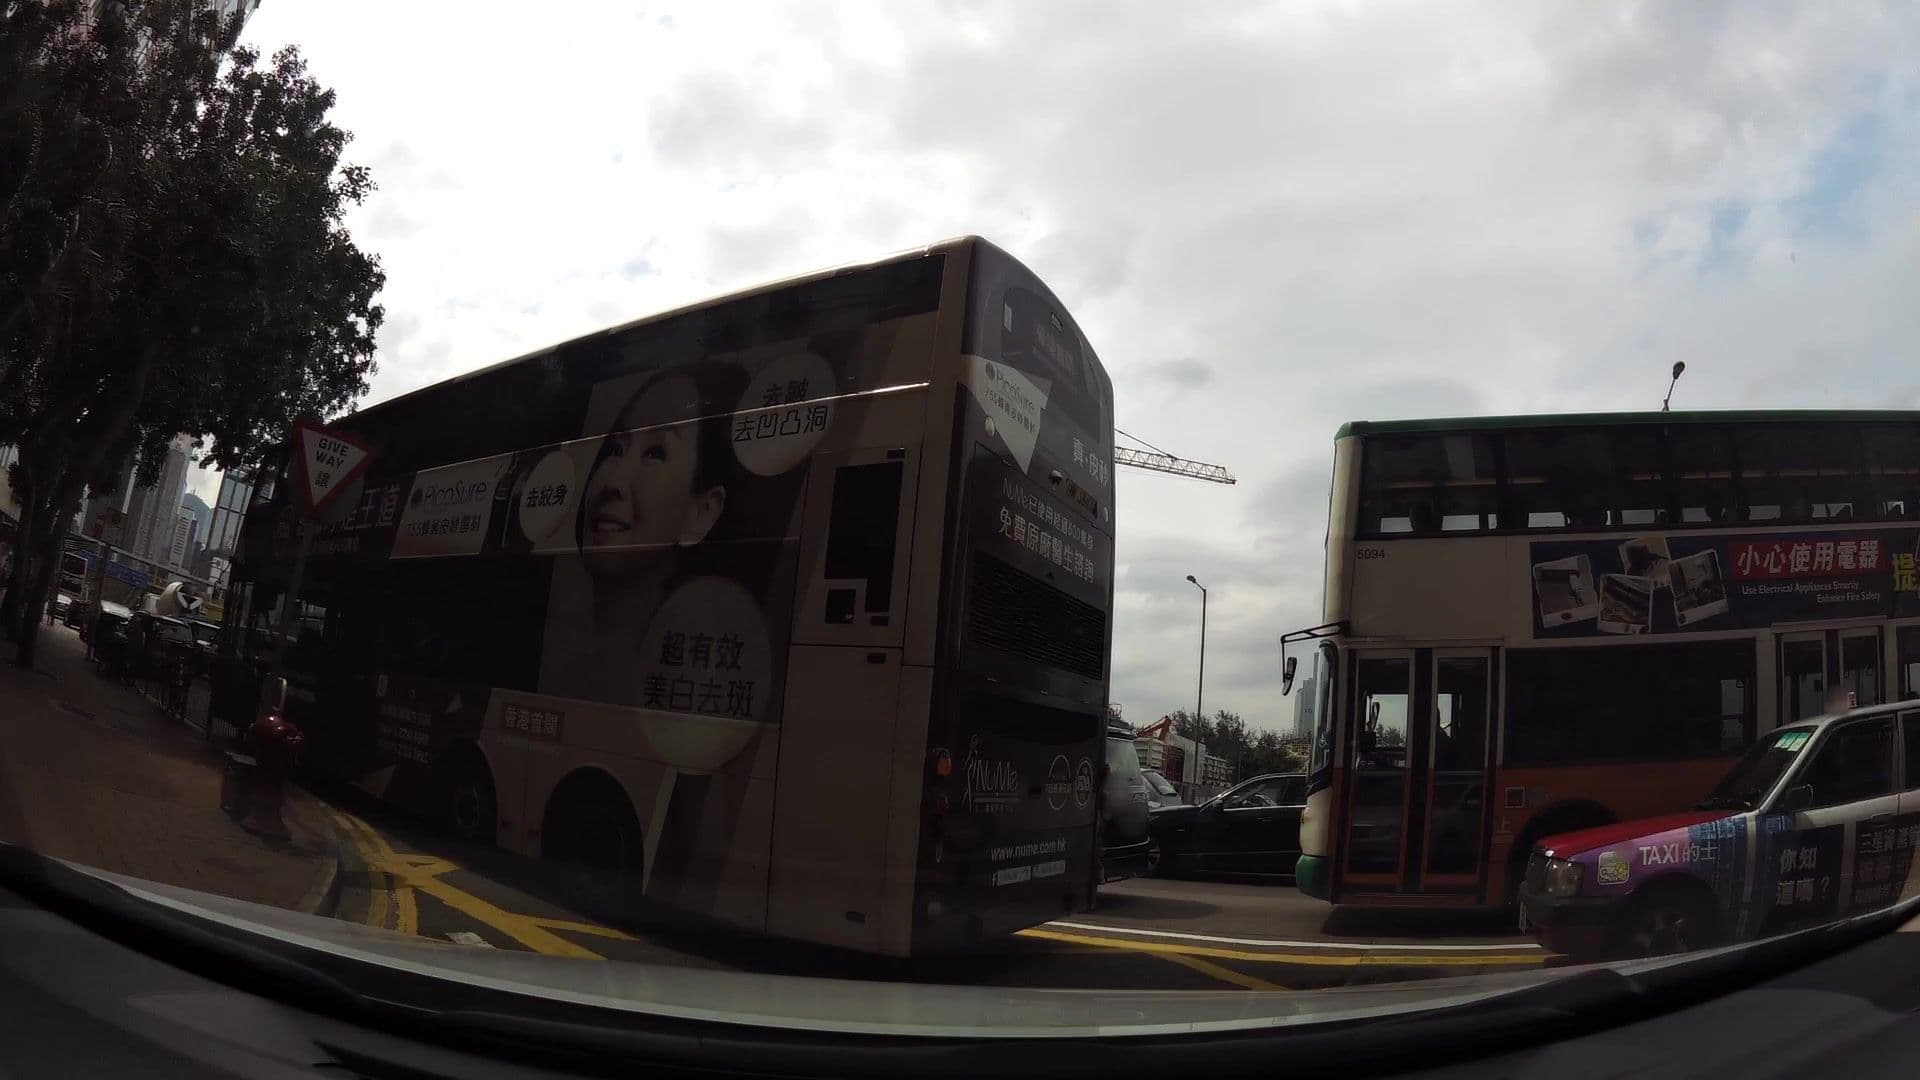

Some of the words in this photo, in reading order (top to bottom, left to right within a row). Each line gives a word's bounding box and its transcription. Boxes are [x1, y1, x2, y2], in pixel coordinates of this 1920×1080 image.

[734, 405, 827, 442] 去凹凸洞
[318, 438, 349, 457] GIVE
[315, 451, 344, 470] WAY
[424, 480, 488, 505] PicoSure
[1357, 548, 1385, 560] 5094
[1737, 540, 1879, 576] 小心使用電器
[1742, 585, 1758, 595] Use
[1759, 583, 1793, 594] Electrical
[1847, 592, 1860, 601] Fire
[660, 630, 744, 672] 超有效
[643, 673, 755, 717] 美白去斑
[990, 837, 1067, 864] www.nume.com.hk
[1639, 846, 1679, 866] TAXI
[1683, 844, 1719, 863] 的士
[1780, 847, 1817, 874] 你知
